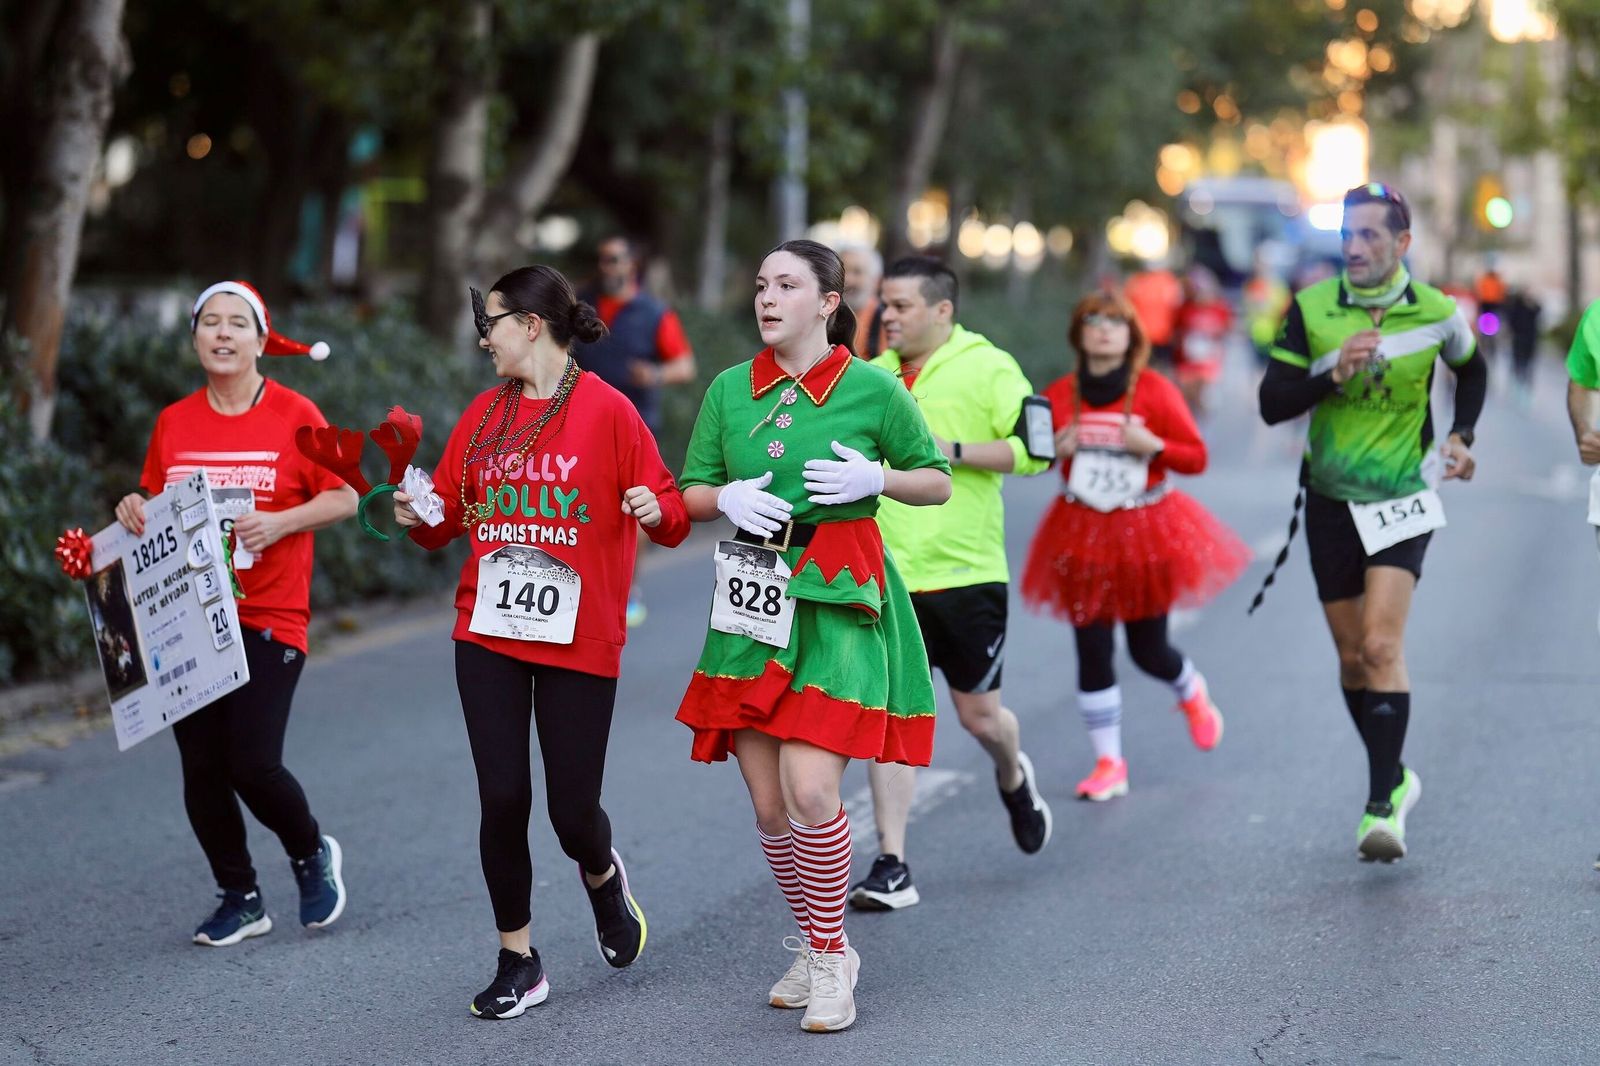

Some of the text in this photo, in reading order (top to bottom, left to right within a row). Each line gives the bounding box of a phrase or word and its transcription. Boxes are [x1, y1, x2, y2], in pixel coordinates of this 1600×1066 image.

[484, 452, 579, 483] HOLLY
[1085, 466, 1132, 495] 755
[477, 483, 580, 519] JOLLY
[1374, 497, 1427, 527] 154
[192, 539, 204, 557] 19
[477, 522, 579, 547] CHRISTMAS
[131, 525, 178, 575] 18225
[507, 570, 533, 578] PALMA
[736, 569, 760, 578] PALMA
[148, 604, 157, 617] DE
[159, 581, 190, 609] NAVIDAD
[496, 579, 560, 617] 140
[728, 577, 782, 617] 828
[212, 607, 229, 635] 20
